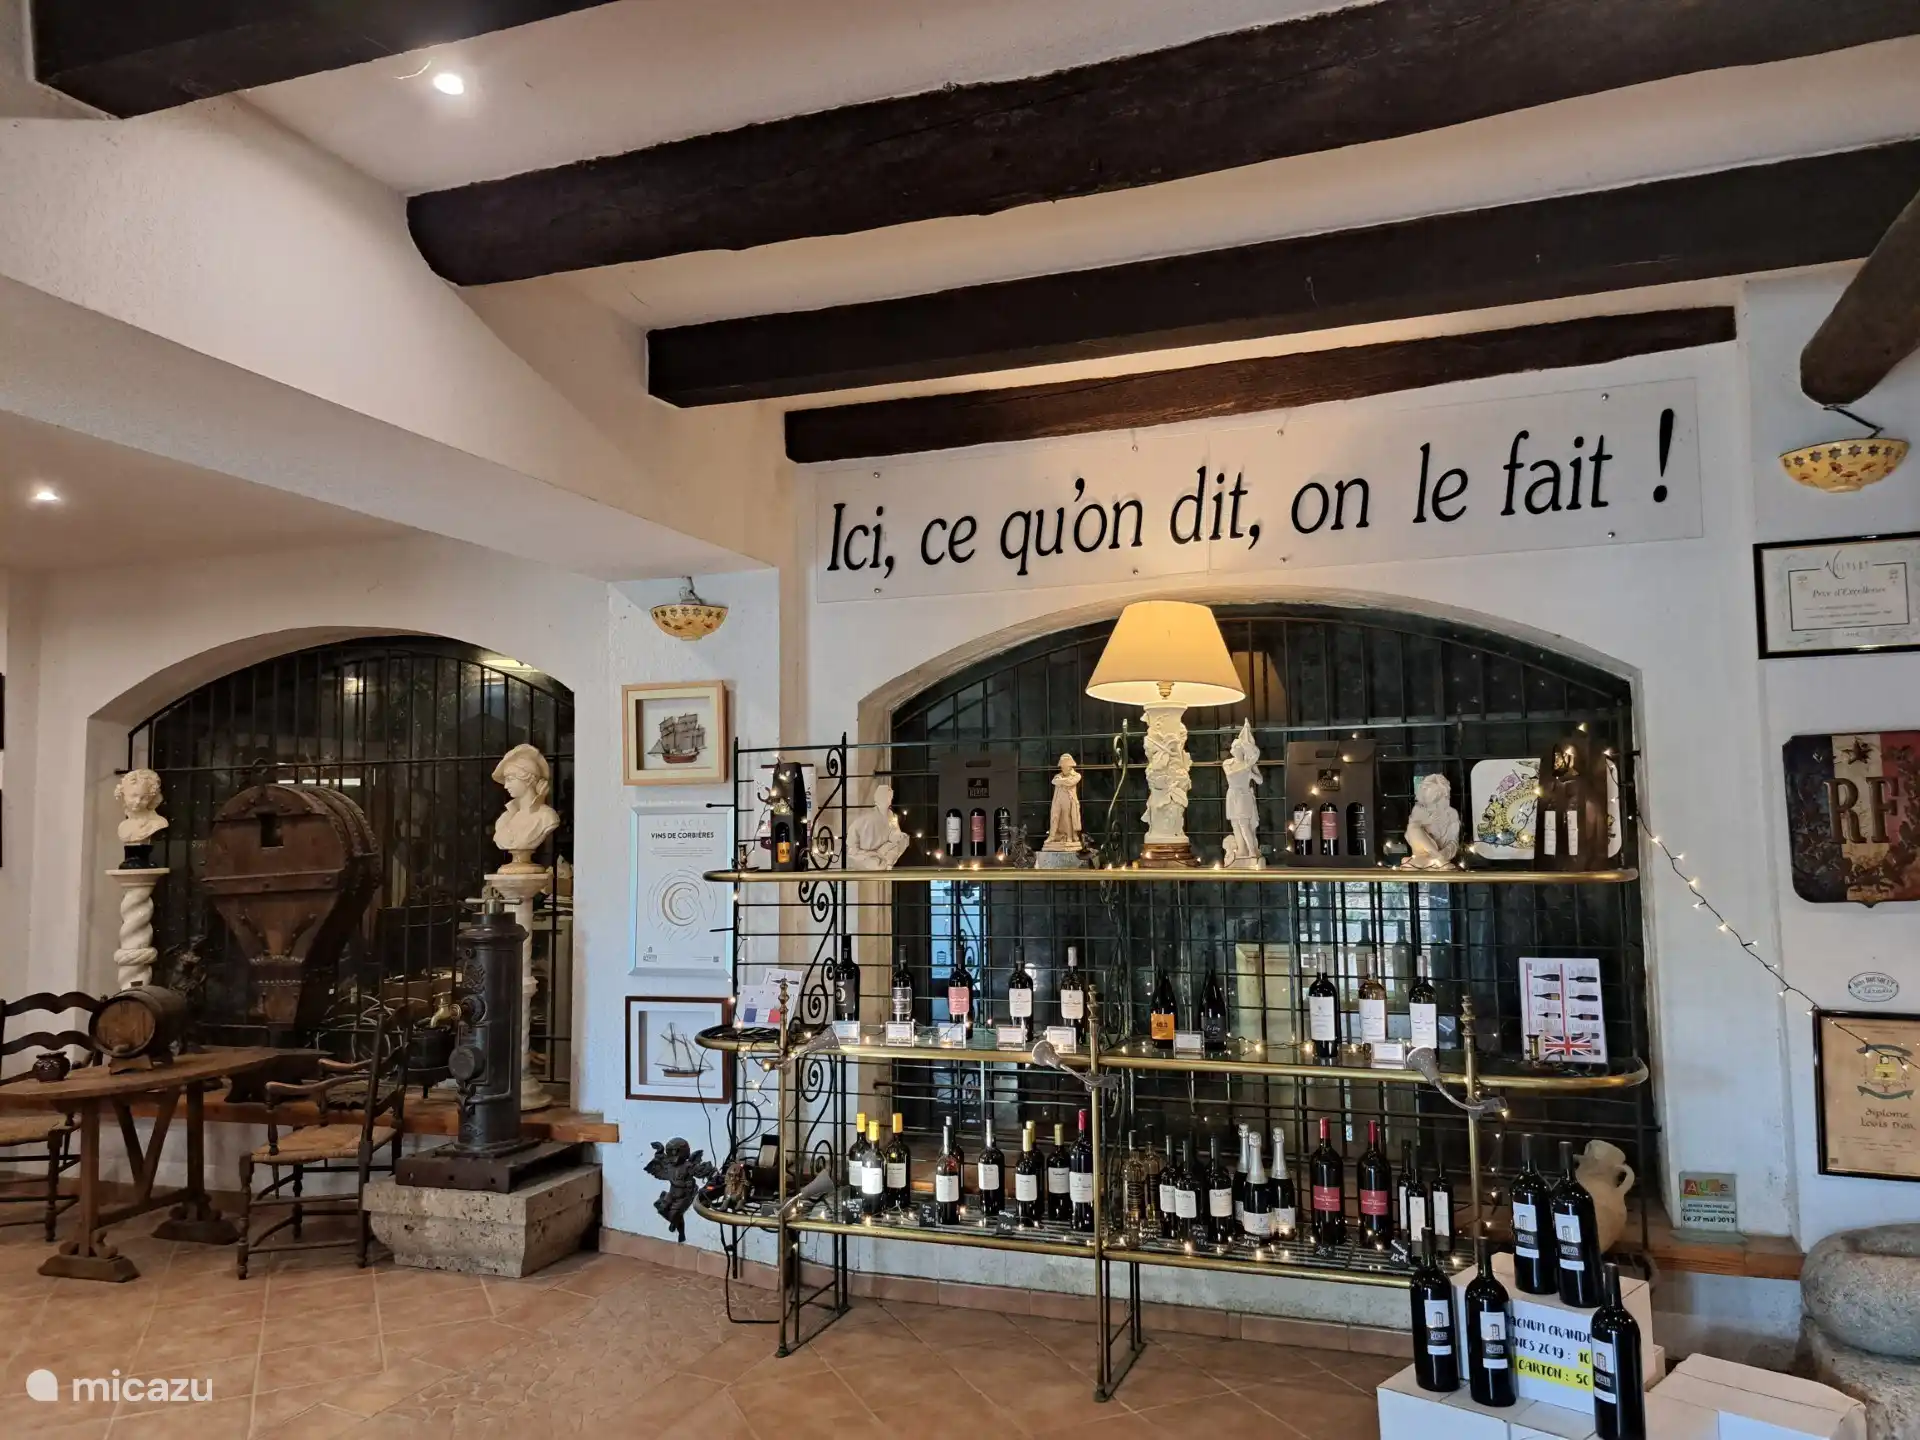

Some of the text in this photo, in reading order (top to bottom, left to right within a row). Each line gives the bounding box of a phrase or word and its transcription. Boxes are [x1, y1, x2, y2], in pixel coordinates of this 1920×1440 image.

[827, 407, 1675, 579] Ici, ce qu'on dit, on le fait !
[1506, 1314, 1546, 1333] AGNUM
[1518, 1359, 1562, 1379] CARTON
